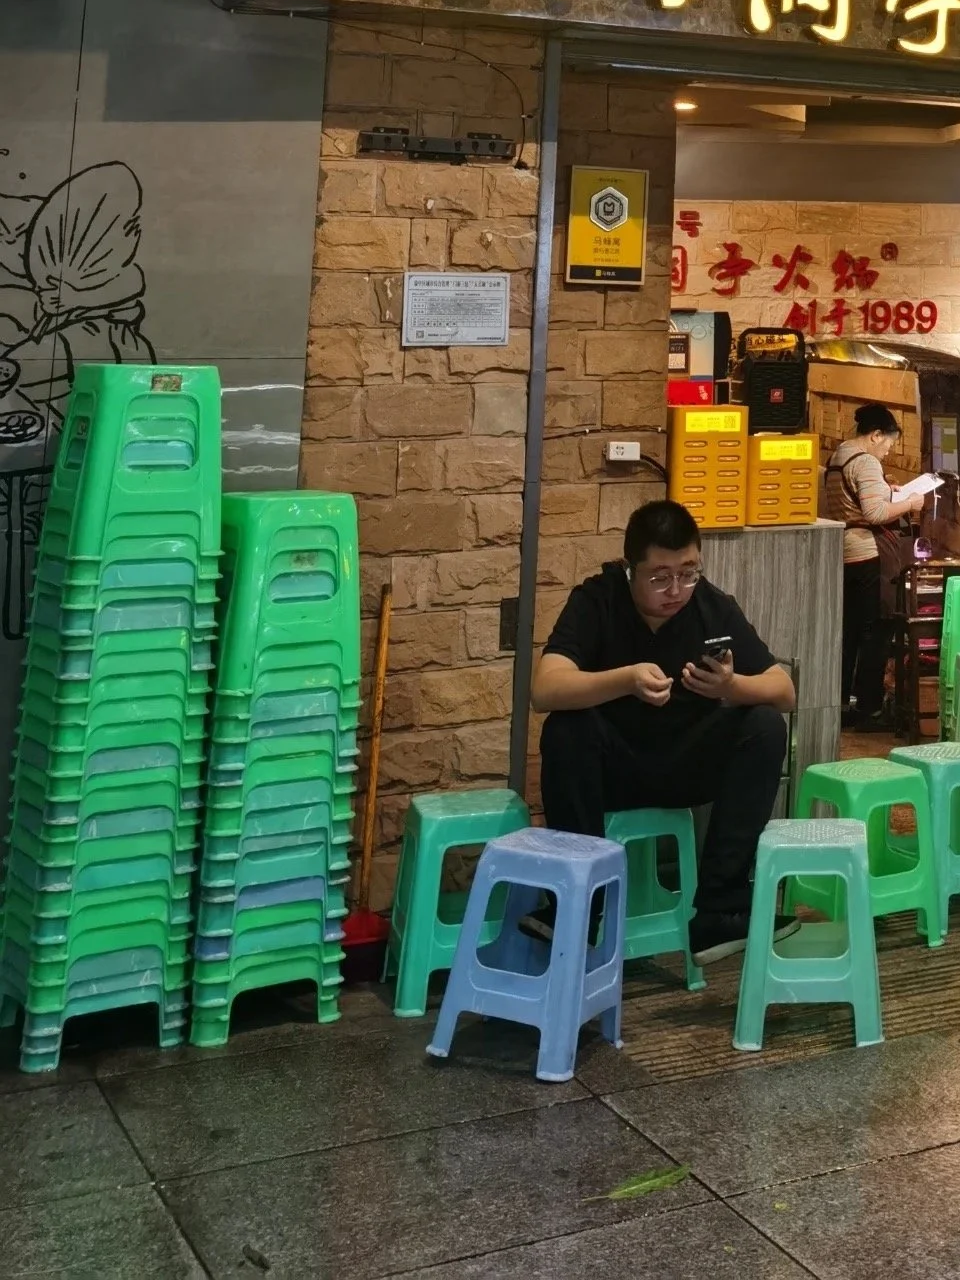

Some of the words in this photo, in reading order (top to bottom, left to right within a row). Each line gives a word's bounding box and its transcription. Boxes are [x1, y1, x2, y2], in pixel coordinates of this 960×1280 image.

[676, 210, 702, 238] 号
[671, 241, 880, 296] 亭火锅
[783, 298, 938, 337] 创于1989
